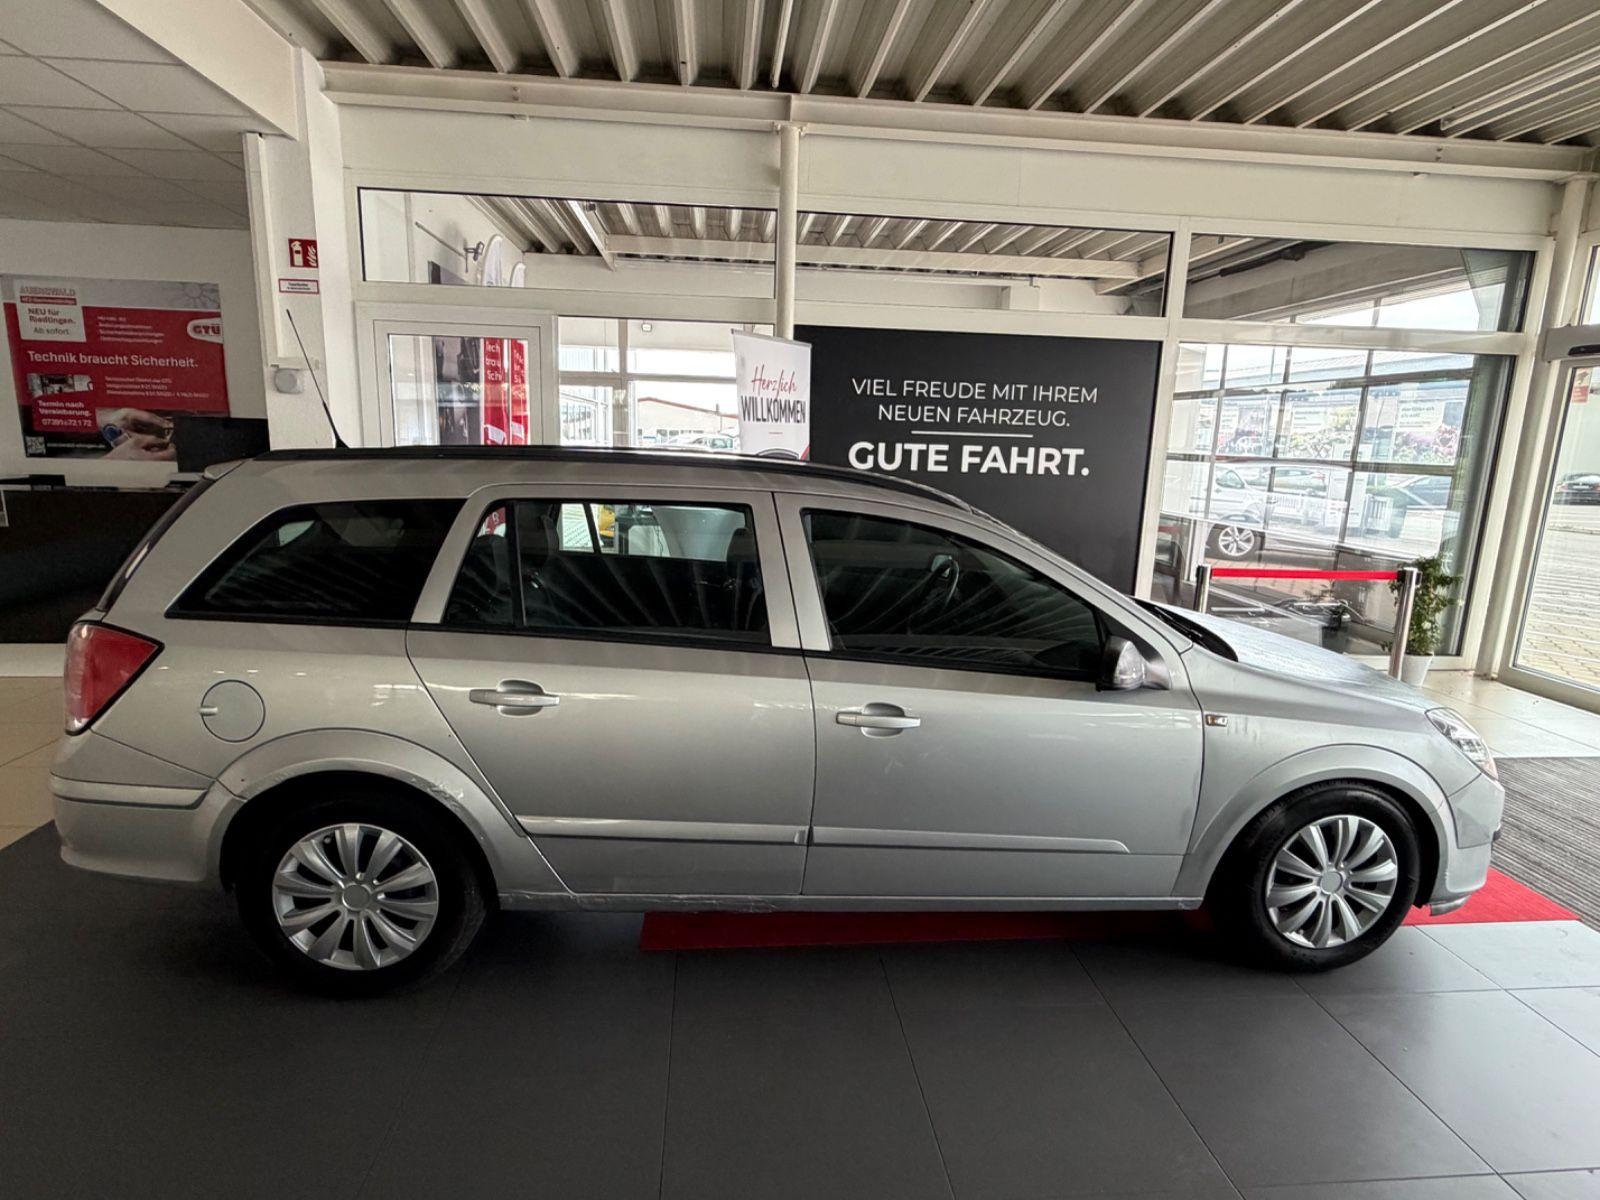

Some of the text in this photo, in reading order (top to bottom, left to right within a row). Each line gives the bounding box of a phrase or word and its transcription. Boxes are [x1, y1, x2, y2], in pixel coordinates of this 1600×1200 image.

[27, 350, 199, 368] Technik braucht Sicherheit.
[751, 364, 797, 399] Herzlich
[852, 378, 1098, 403] VIEL FREUDE MIT IHREM
[741, 395, 807, 424] WILLKOMMEN
[878, 404, 1070, 427] NEUEN FAHRZEUG.
[848, 441, 1090, 476] GUTE FAHRT.
